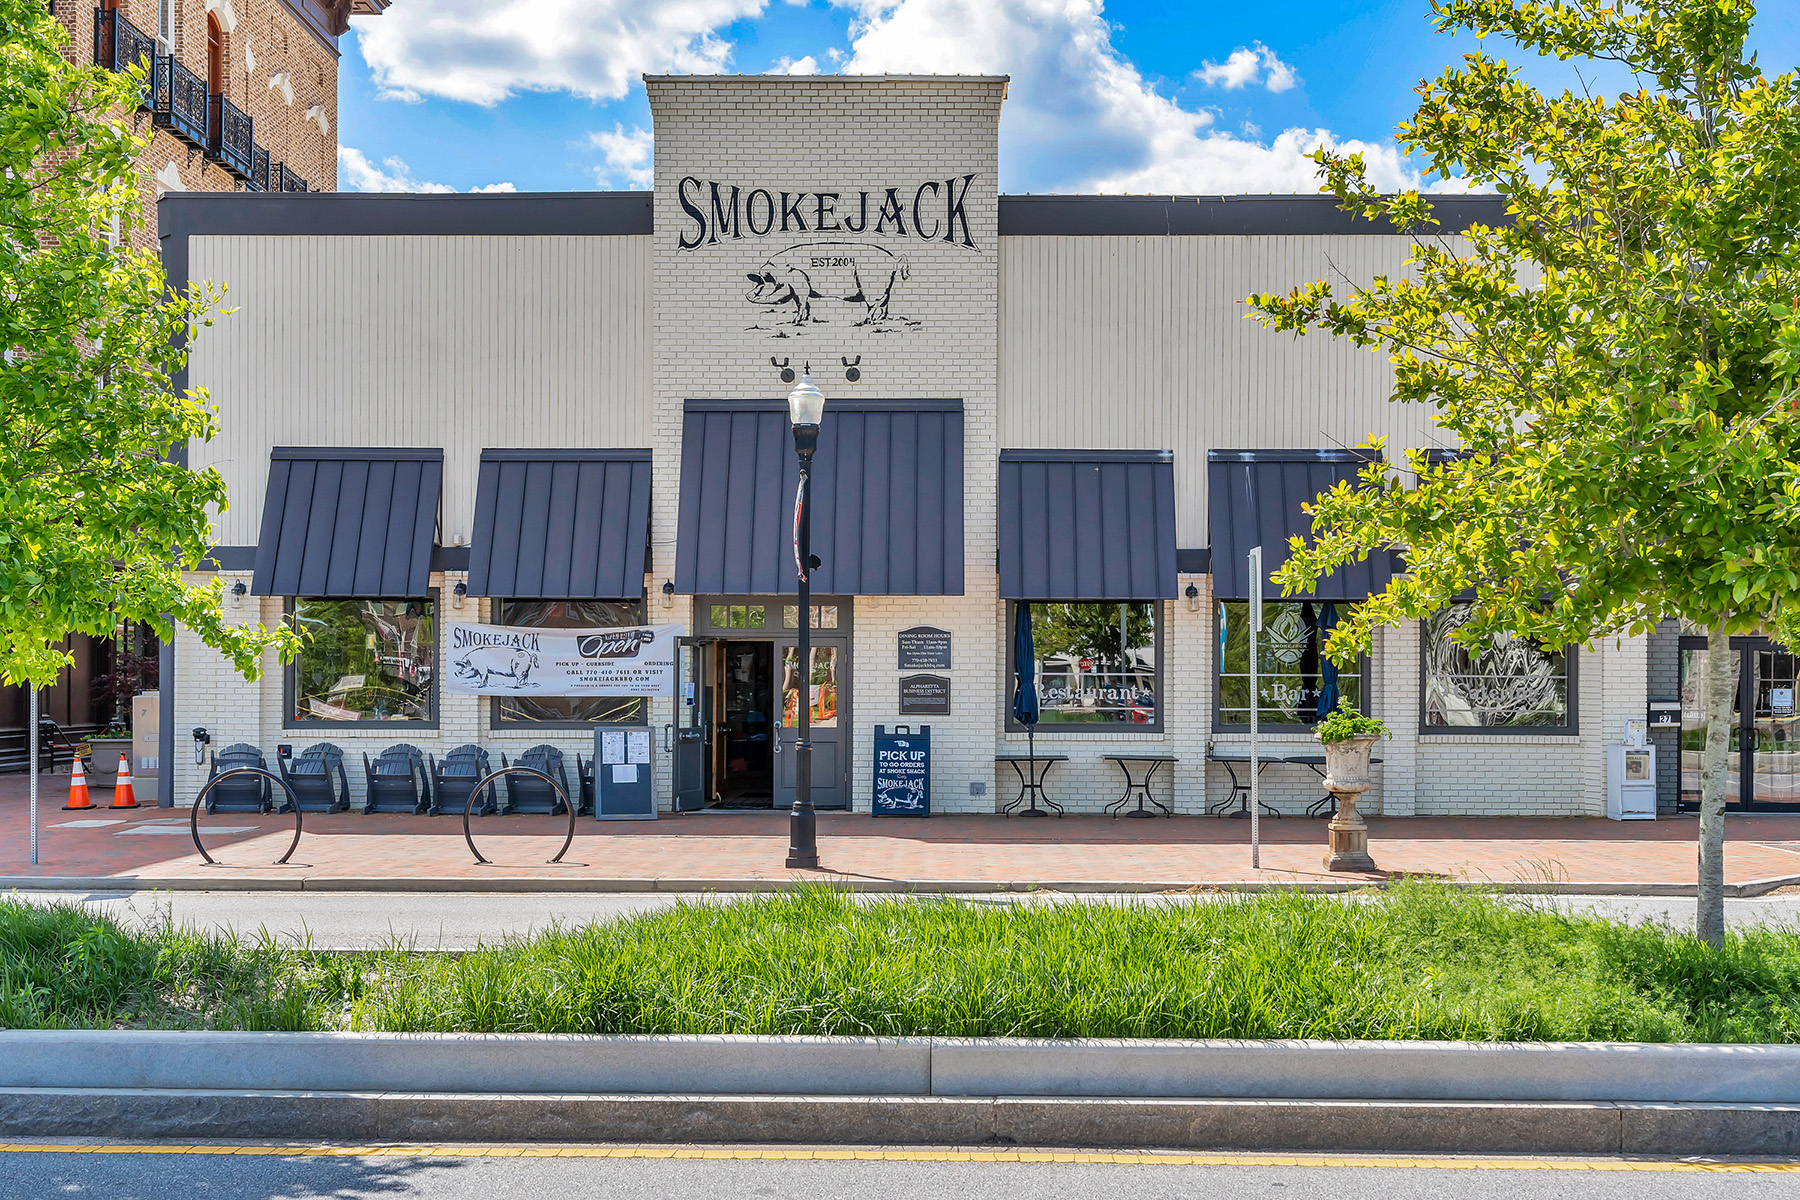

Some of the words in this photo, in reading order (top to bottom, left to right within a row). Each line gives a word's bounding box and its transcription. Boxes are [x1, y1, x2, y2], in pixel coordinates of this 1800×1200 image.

[677, 173, 982, 253] SMOKEJACK
[453, 627, 541, 653] SMOKEJACK
[579, 635, 639, 661] Open
[1271, 684, 1310, 701] Bar
[1454, 682, 1542, 701] Catering
[1660, 715, 1671, 723] 27
[879, 750, 908, 760] PICK
[910, 750, 926, 760] UP
[877, 777, 924, 790] SMOKEJACK
